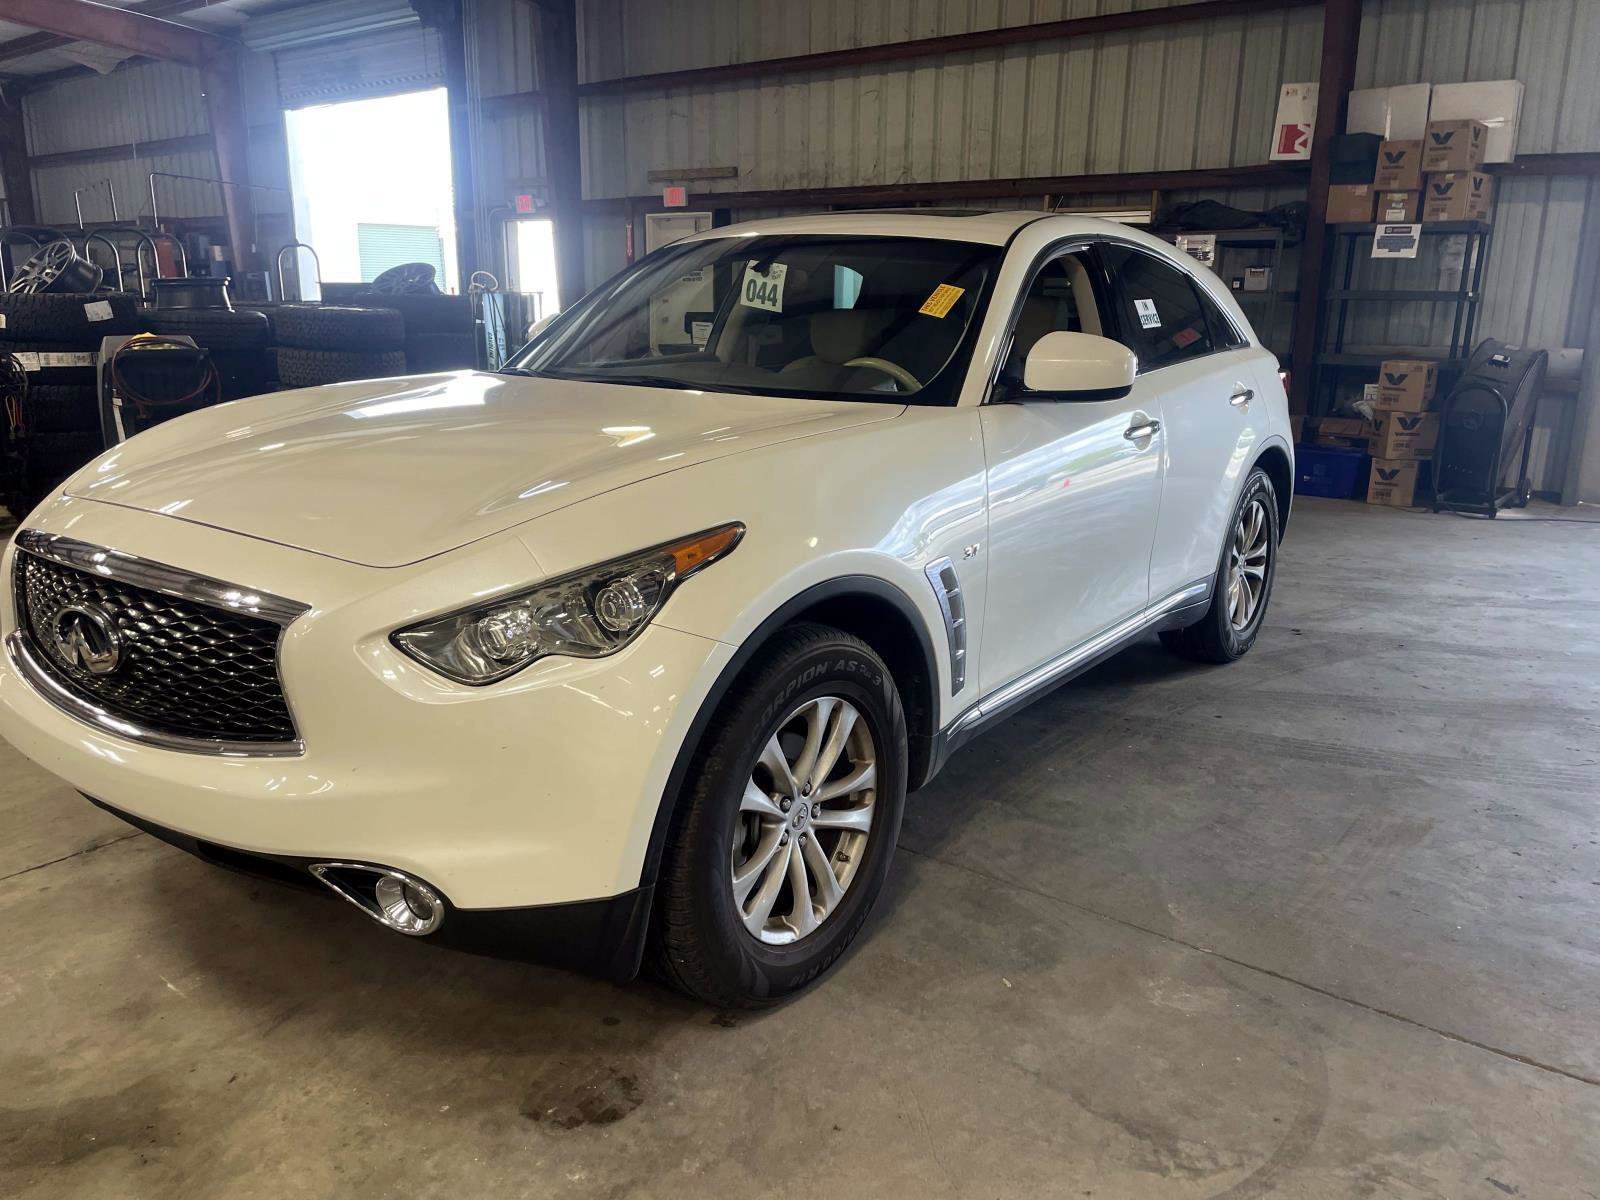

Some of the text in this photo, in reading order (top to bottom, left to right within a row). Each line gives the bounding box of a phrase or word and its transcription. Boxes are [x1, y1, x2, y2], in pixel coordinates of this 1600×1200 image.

[746, 278, 778, 307] 044
[1141, 301, 1149, 311] IN
[1140, 313, 1159, 325] SERVICE
[834, 659, 857, 671] AS
